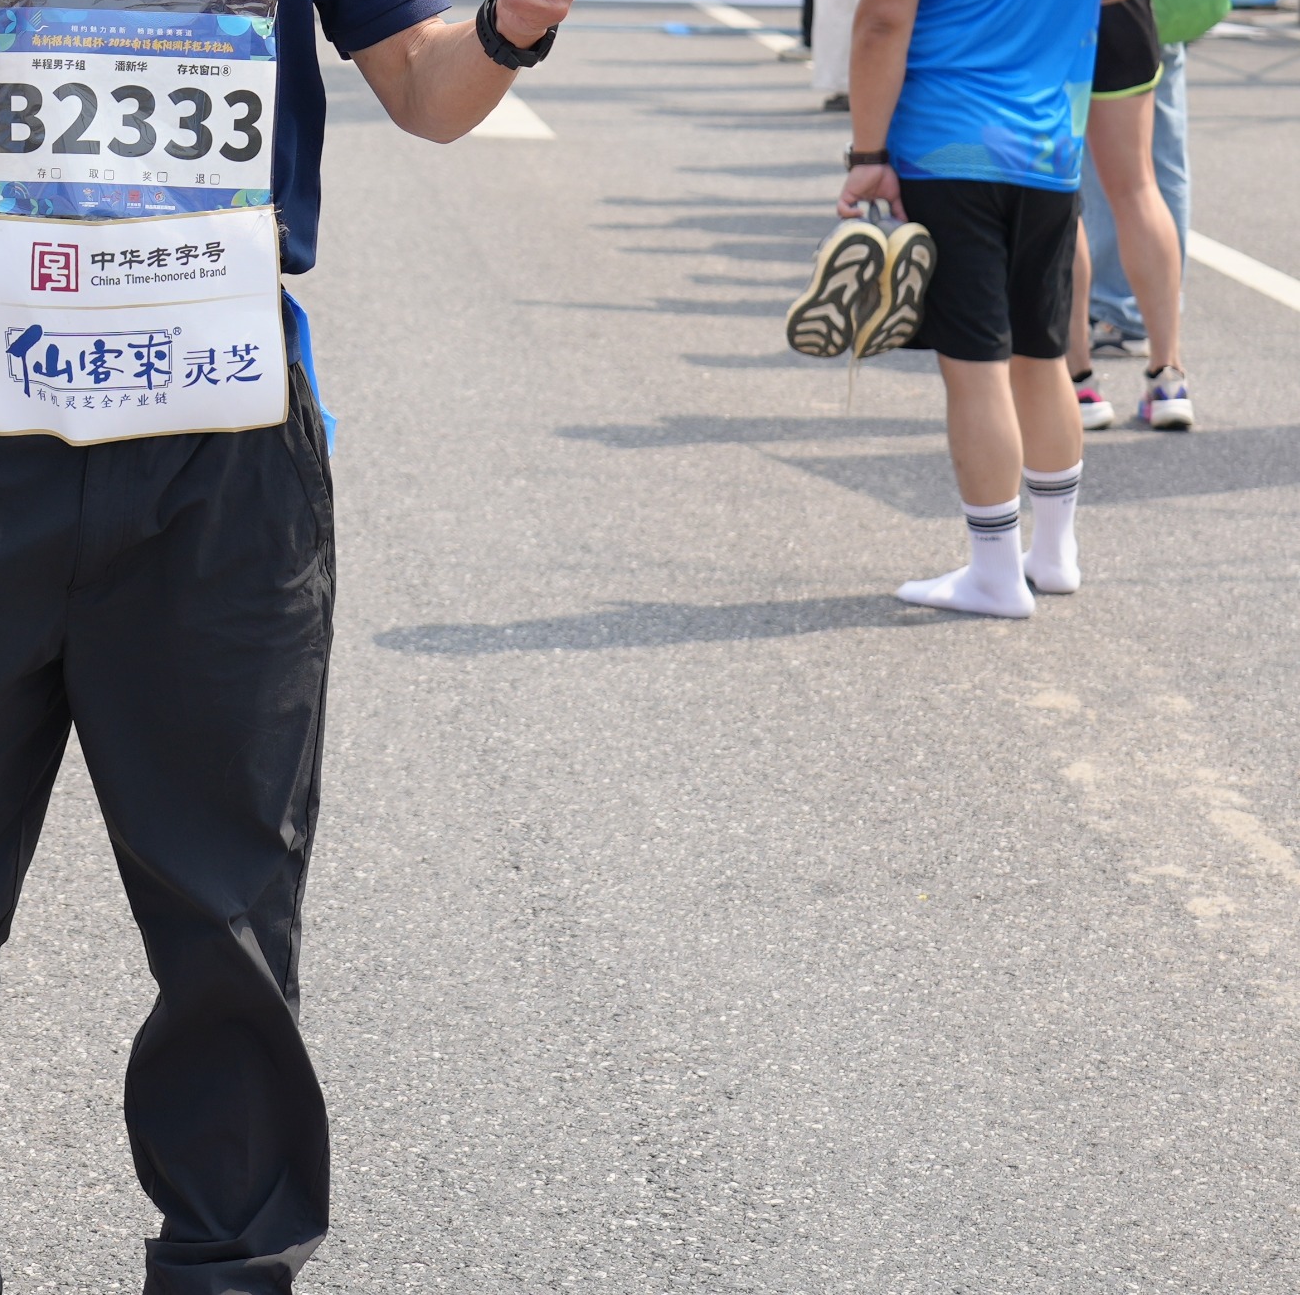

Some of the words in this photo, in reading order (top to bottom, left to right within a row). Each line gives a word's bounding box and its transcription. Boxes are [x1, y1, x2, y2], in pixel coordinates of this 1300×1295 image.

[71, 24, 126, 34] 相约魅力高新
[137, 27, 193, 37] 畅跑最美赛道
[31, 58, 86, 71] 半程男子组
[114, 60, 148, 72] 潘新华
[37, 168, 47, 179] 存
[89, 169, 99, 179] 取
[142, 171, 152, 182] 奖
[195, 173, 205, 184] 退
[90, 241, 226, 272] 中华老字号
[90, 275, 121, 287] China
[124, 269, 196, 285] Time-honored
[199, 265, 227, 279] Brand
[182, 343, 264, 389] 灵芝
[36, 387, 168, 409] 有机灵芝全产业链
